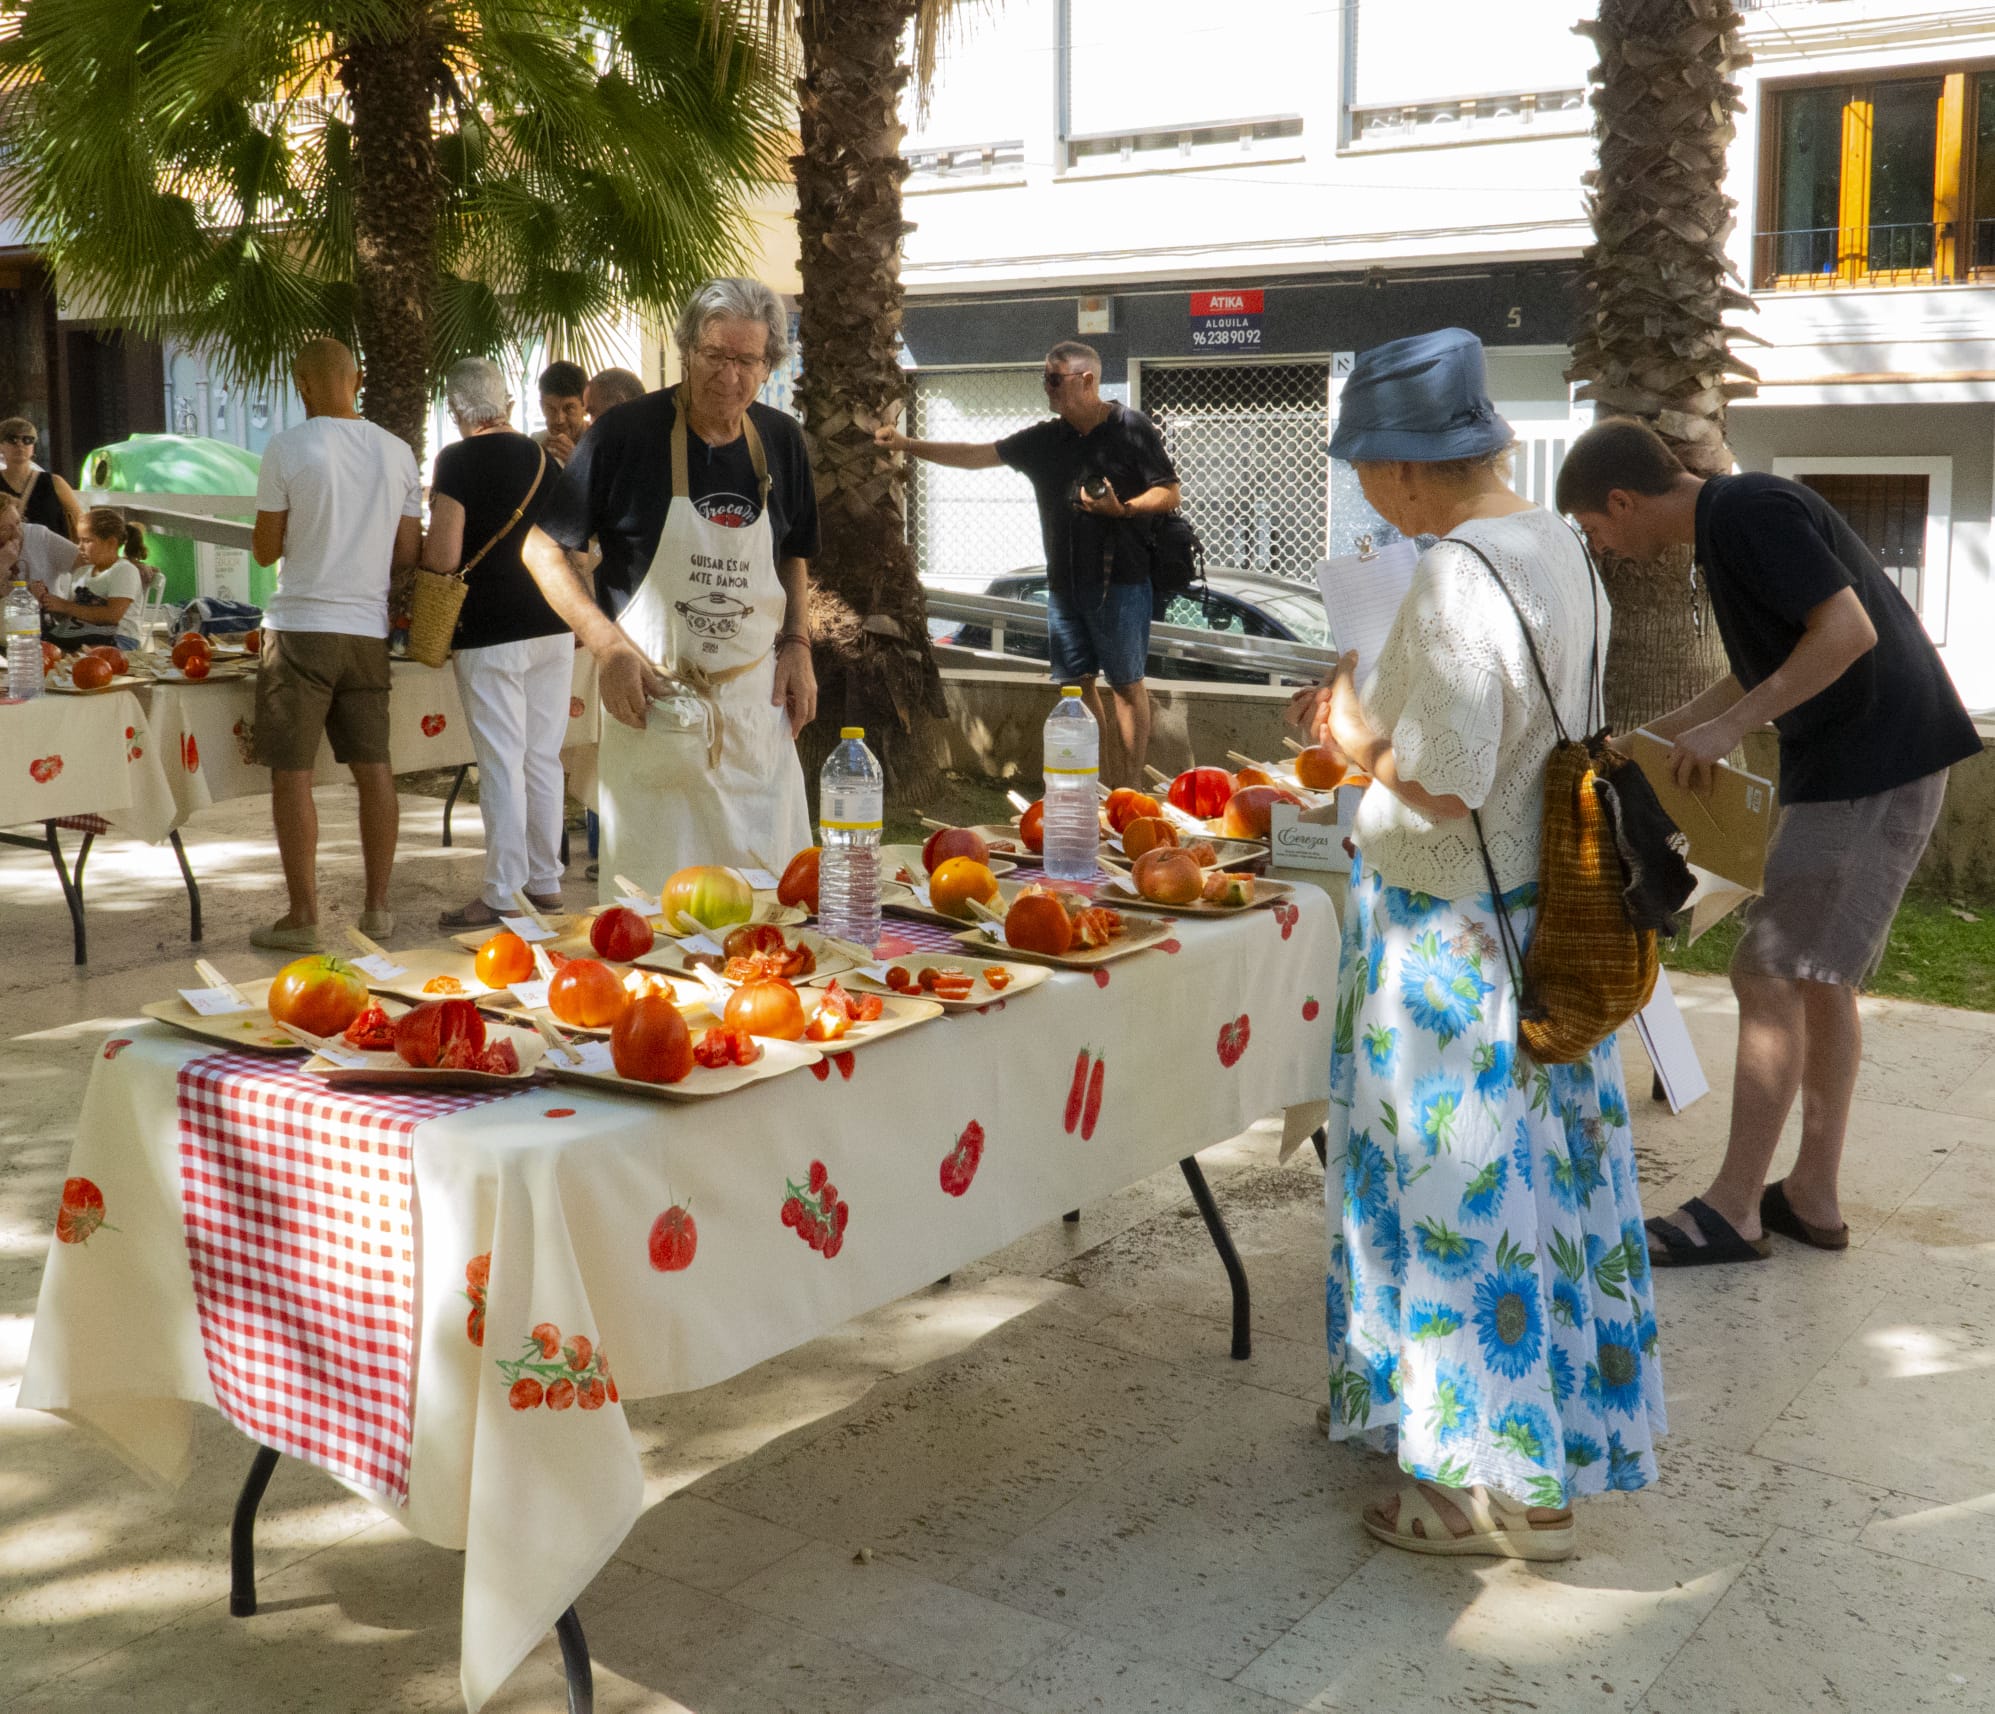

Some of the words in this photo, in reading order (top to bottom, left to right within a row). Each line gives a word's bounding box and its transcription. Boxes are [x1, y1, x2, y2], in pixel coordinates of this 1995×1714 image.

[1209, 295, 1244, 309] ATIKA
[1205, 318, 1249, 329] ALQUILA
[1507, 306, 1521, 328] 5
[690, 553, 724, 571] GUISAR
[726, 557, 738, 572] ÉS
[739, 560, 750, 572] UN
[689, 570, 713, 586] ACTE
[1277, 826, 1328, 850] Cerezas
